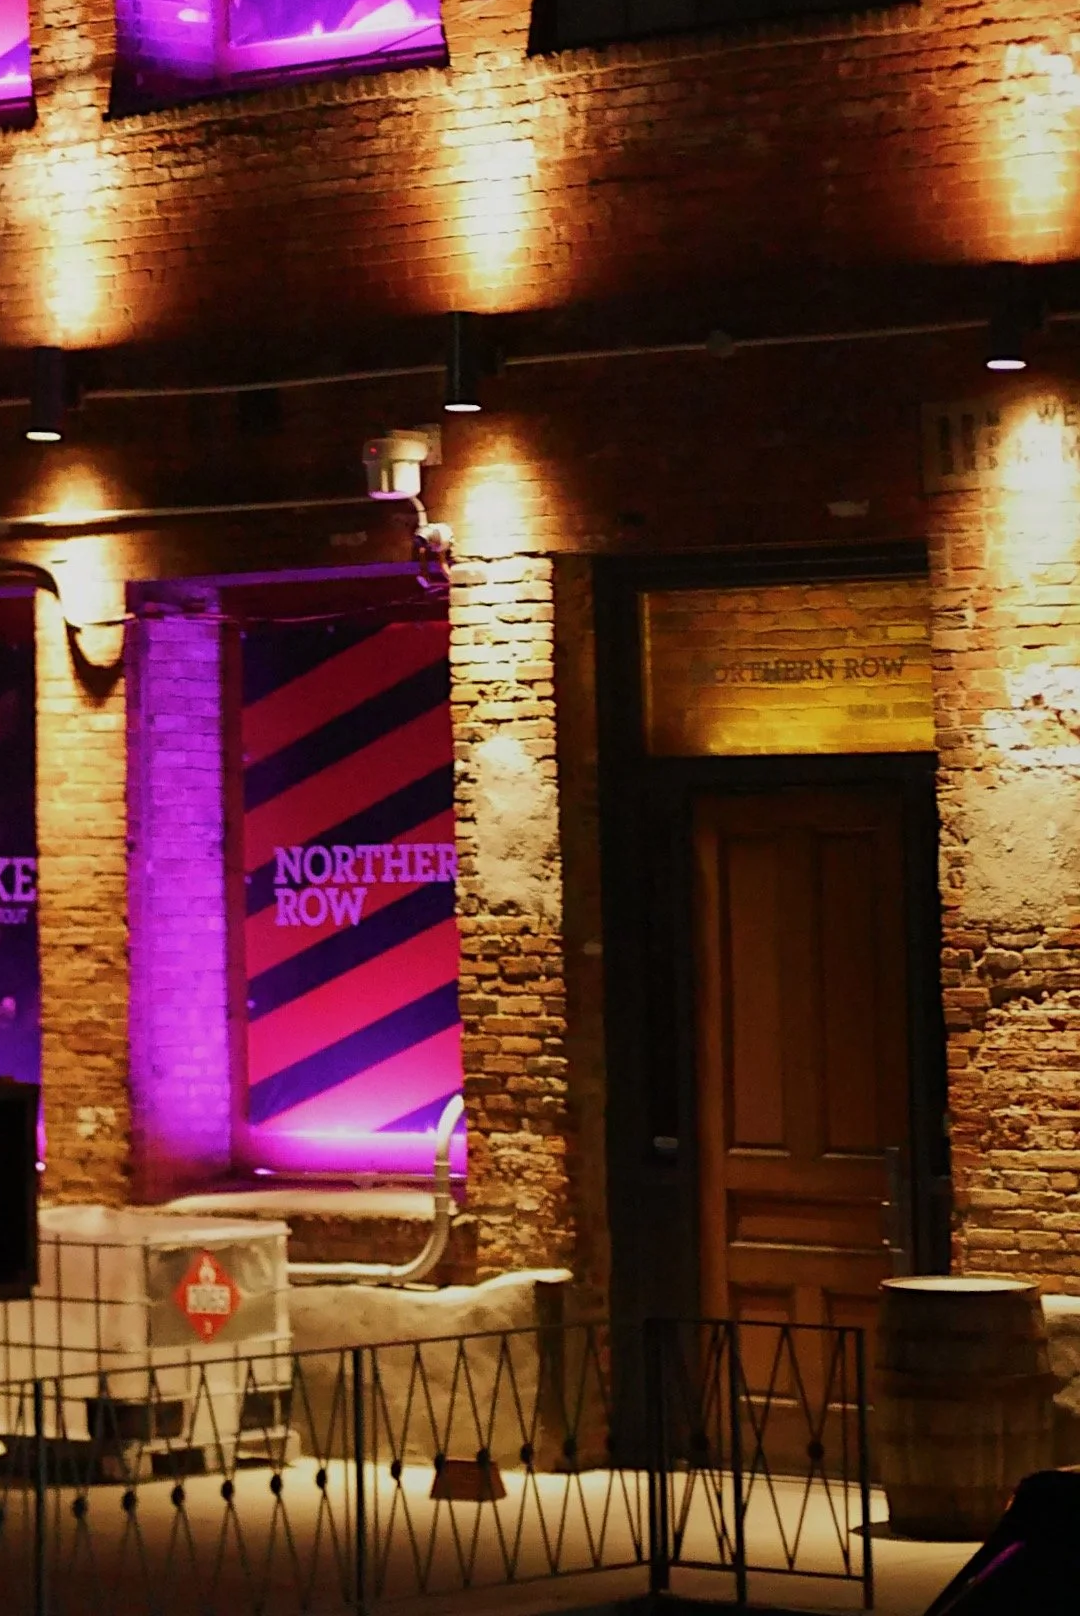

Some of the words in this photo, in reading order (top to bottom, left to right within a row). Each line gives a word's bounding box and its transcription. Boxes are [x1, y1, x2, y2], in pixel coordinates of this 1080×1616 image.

[700, 658, 834, 684] ORTHERN
[841, 654, 909, 681] ROW
[273, 843, 457, 885] NORTHER
[274, 887, 368, 927] ROW
